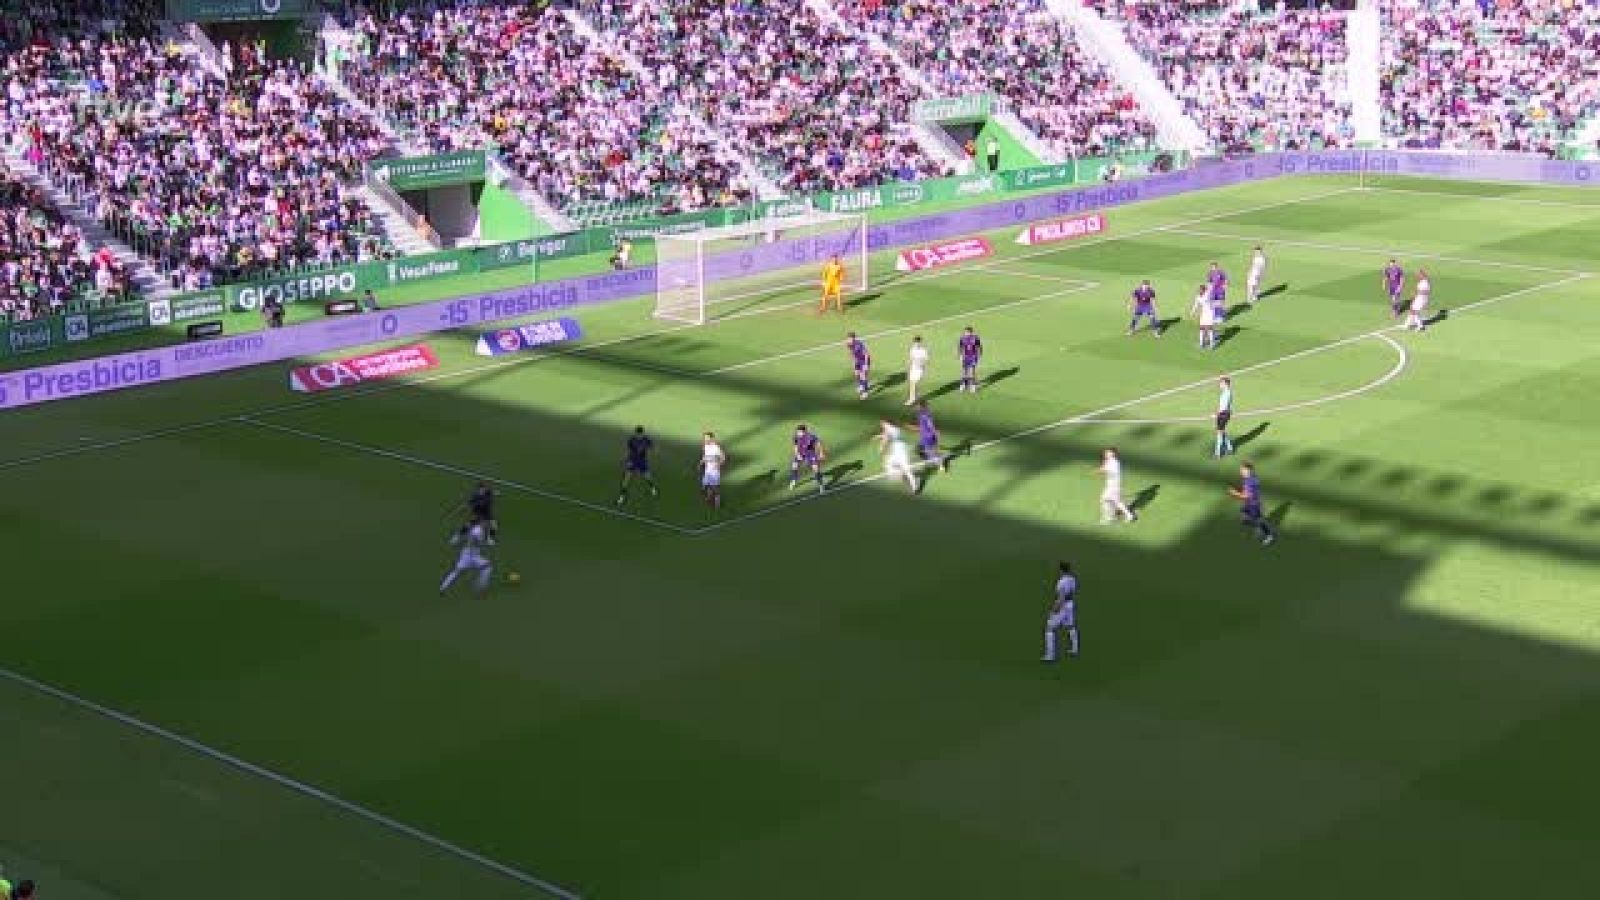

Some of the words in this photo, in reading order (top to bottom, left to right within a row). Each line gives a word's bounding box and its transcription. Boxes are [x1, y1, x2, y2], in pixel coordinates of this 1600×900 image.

[832, 189, 881, 212] FAURA
[239, 272, 356, 309] GIOSEPPO
[480, 284, 577, 321] Presbicia
[24, 354, 161, 401] Presbicia
[174, 336, 264, 361] DESCUENTO
